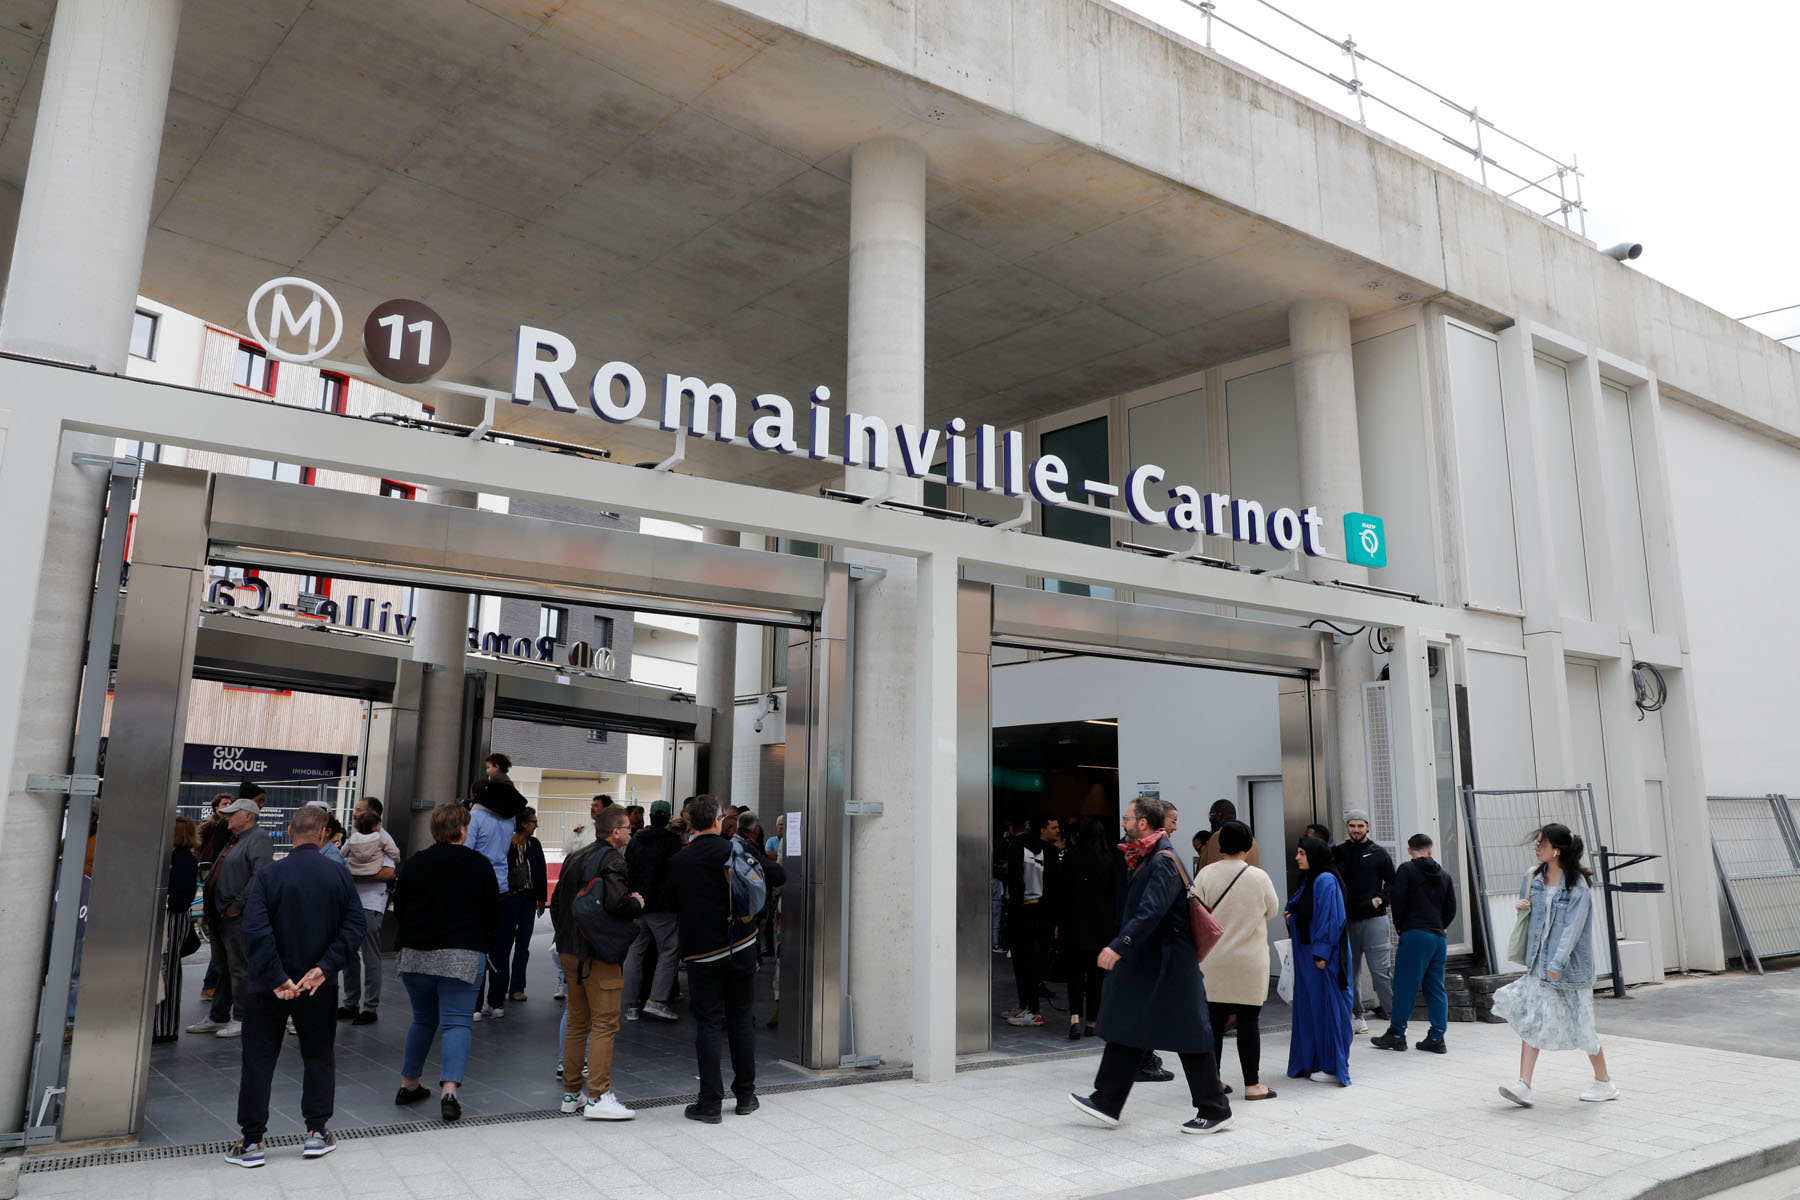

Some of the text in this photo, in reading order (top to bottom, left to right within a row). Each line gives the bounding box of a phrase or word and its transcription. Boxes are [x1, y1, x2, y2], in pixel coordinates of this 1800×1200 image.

[378, 313, 433, 366] 11
[213, 746, 244, 760] GUY
[292, 767, 334, 777] IMMOBILIER
